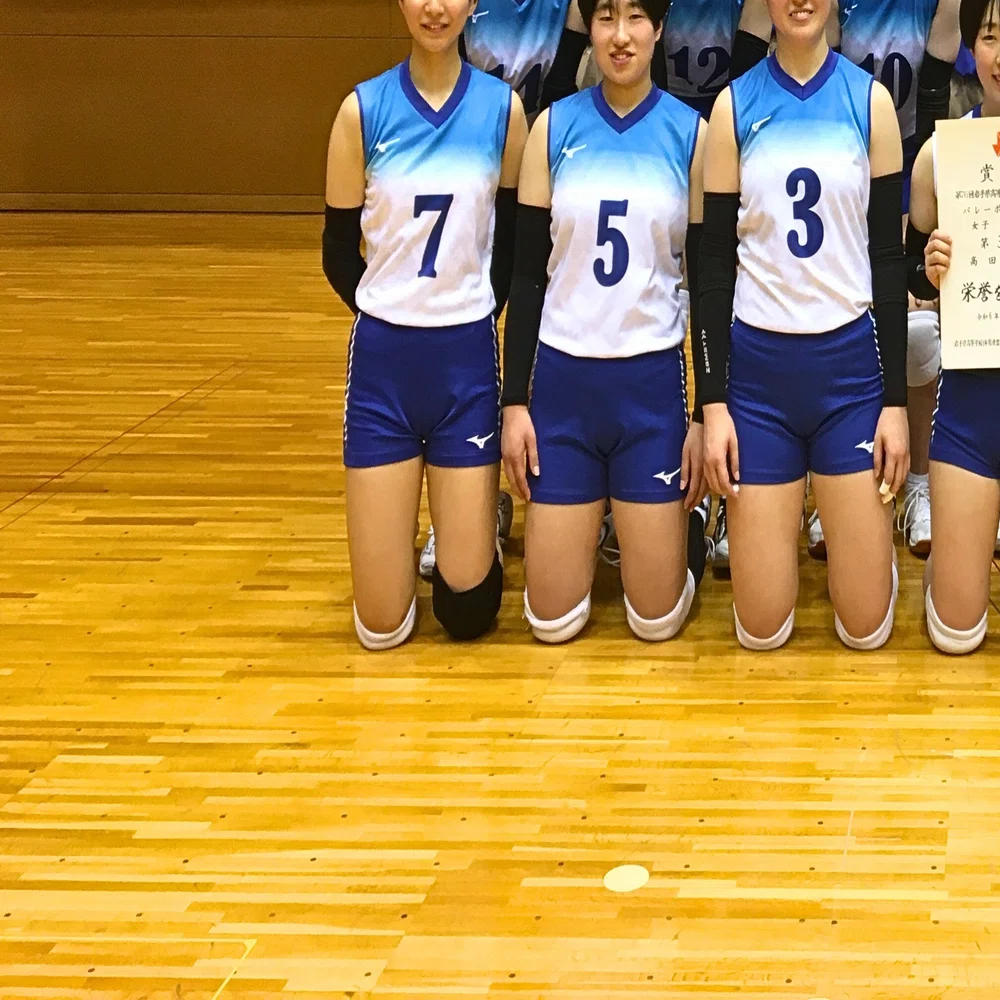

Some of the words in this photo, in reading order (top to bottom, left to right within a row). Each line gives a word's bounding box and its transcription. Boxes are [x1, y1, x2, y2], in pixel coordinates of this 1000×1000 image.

[668, 46, 731, 93] 12
[413, 194, 454, 278] 7
[593, 199, 630, 287] 5
[786, 167, 824, 258] 3
[972, 220, 990, 230] 女子
